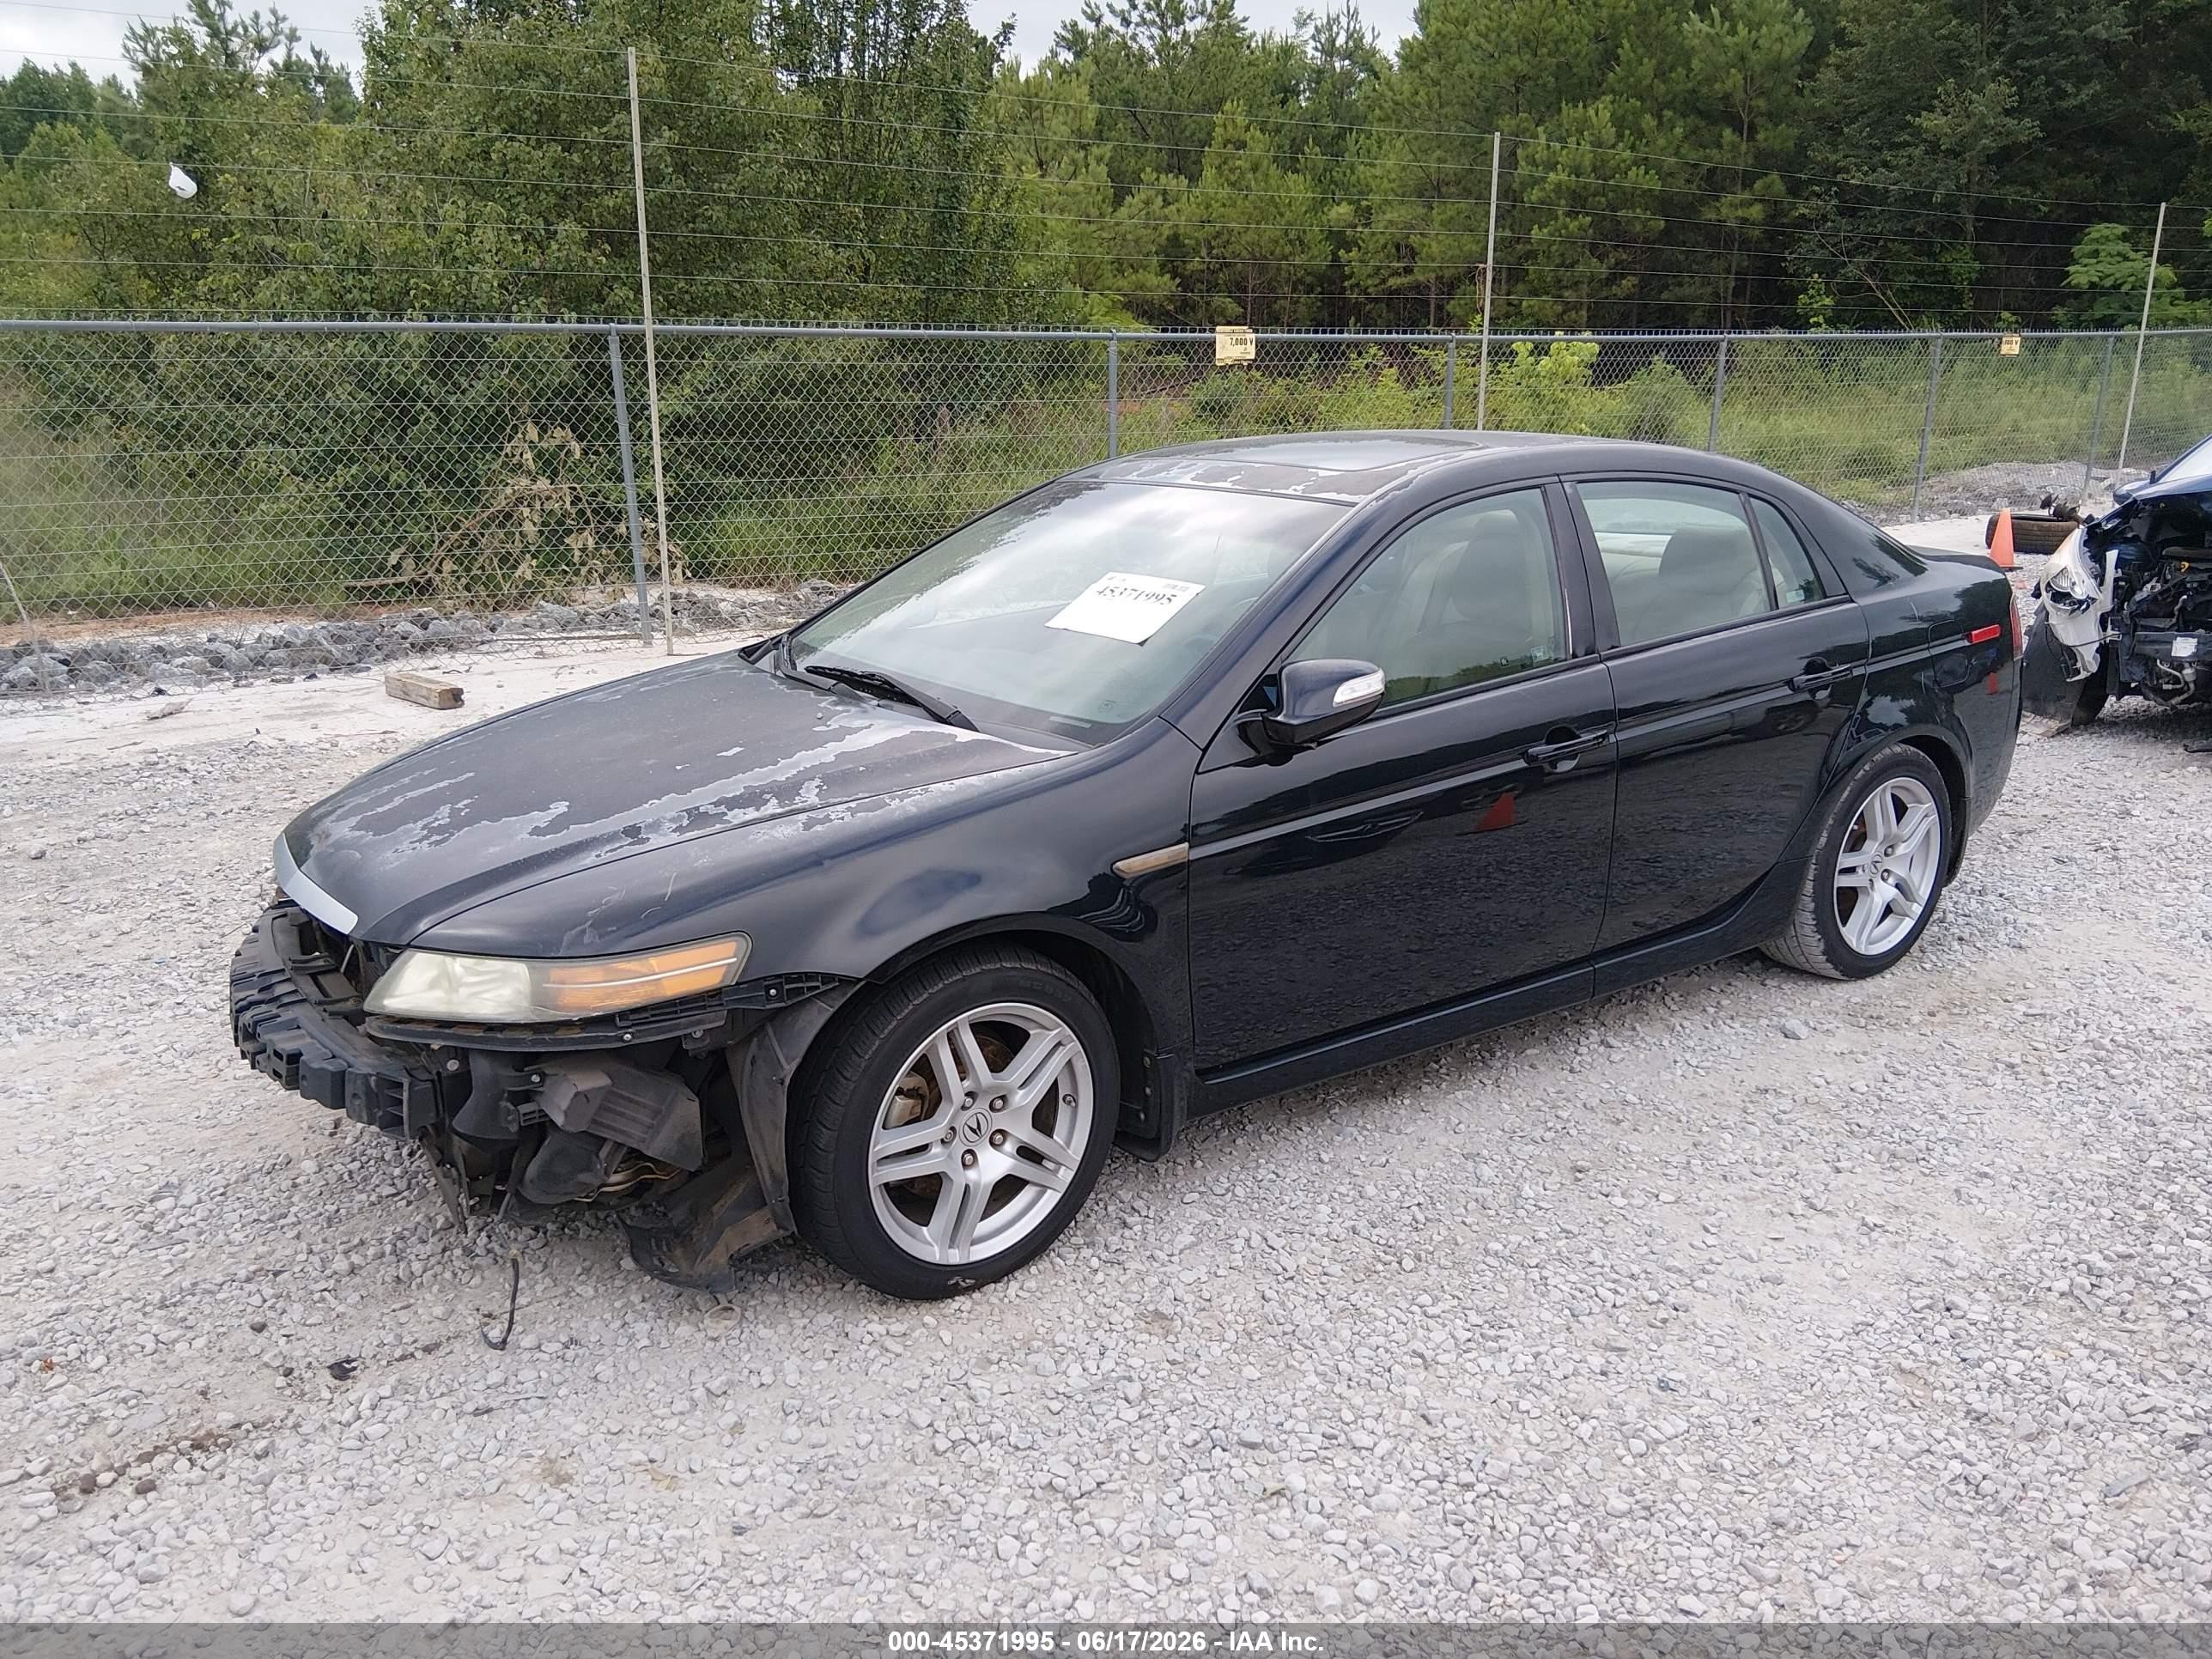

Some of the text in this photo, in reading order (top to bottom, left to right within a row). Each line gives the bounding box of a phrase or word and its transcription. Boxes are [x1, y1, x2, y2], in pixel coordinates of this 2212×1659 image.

[1230, 337, 1254, 347] 7,000 V
[1097, 586, 1177, 605] 45371995
